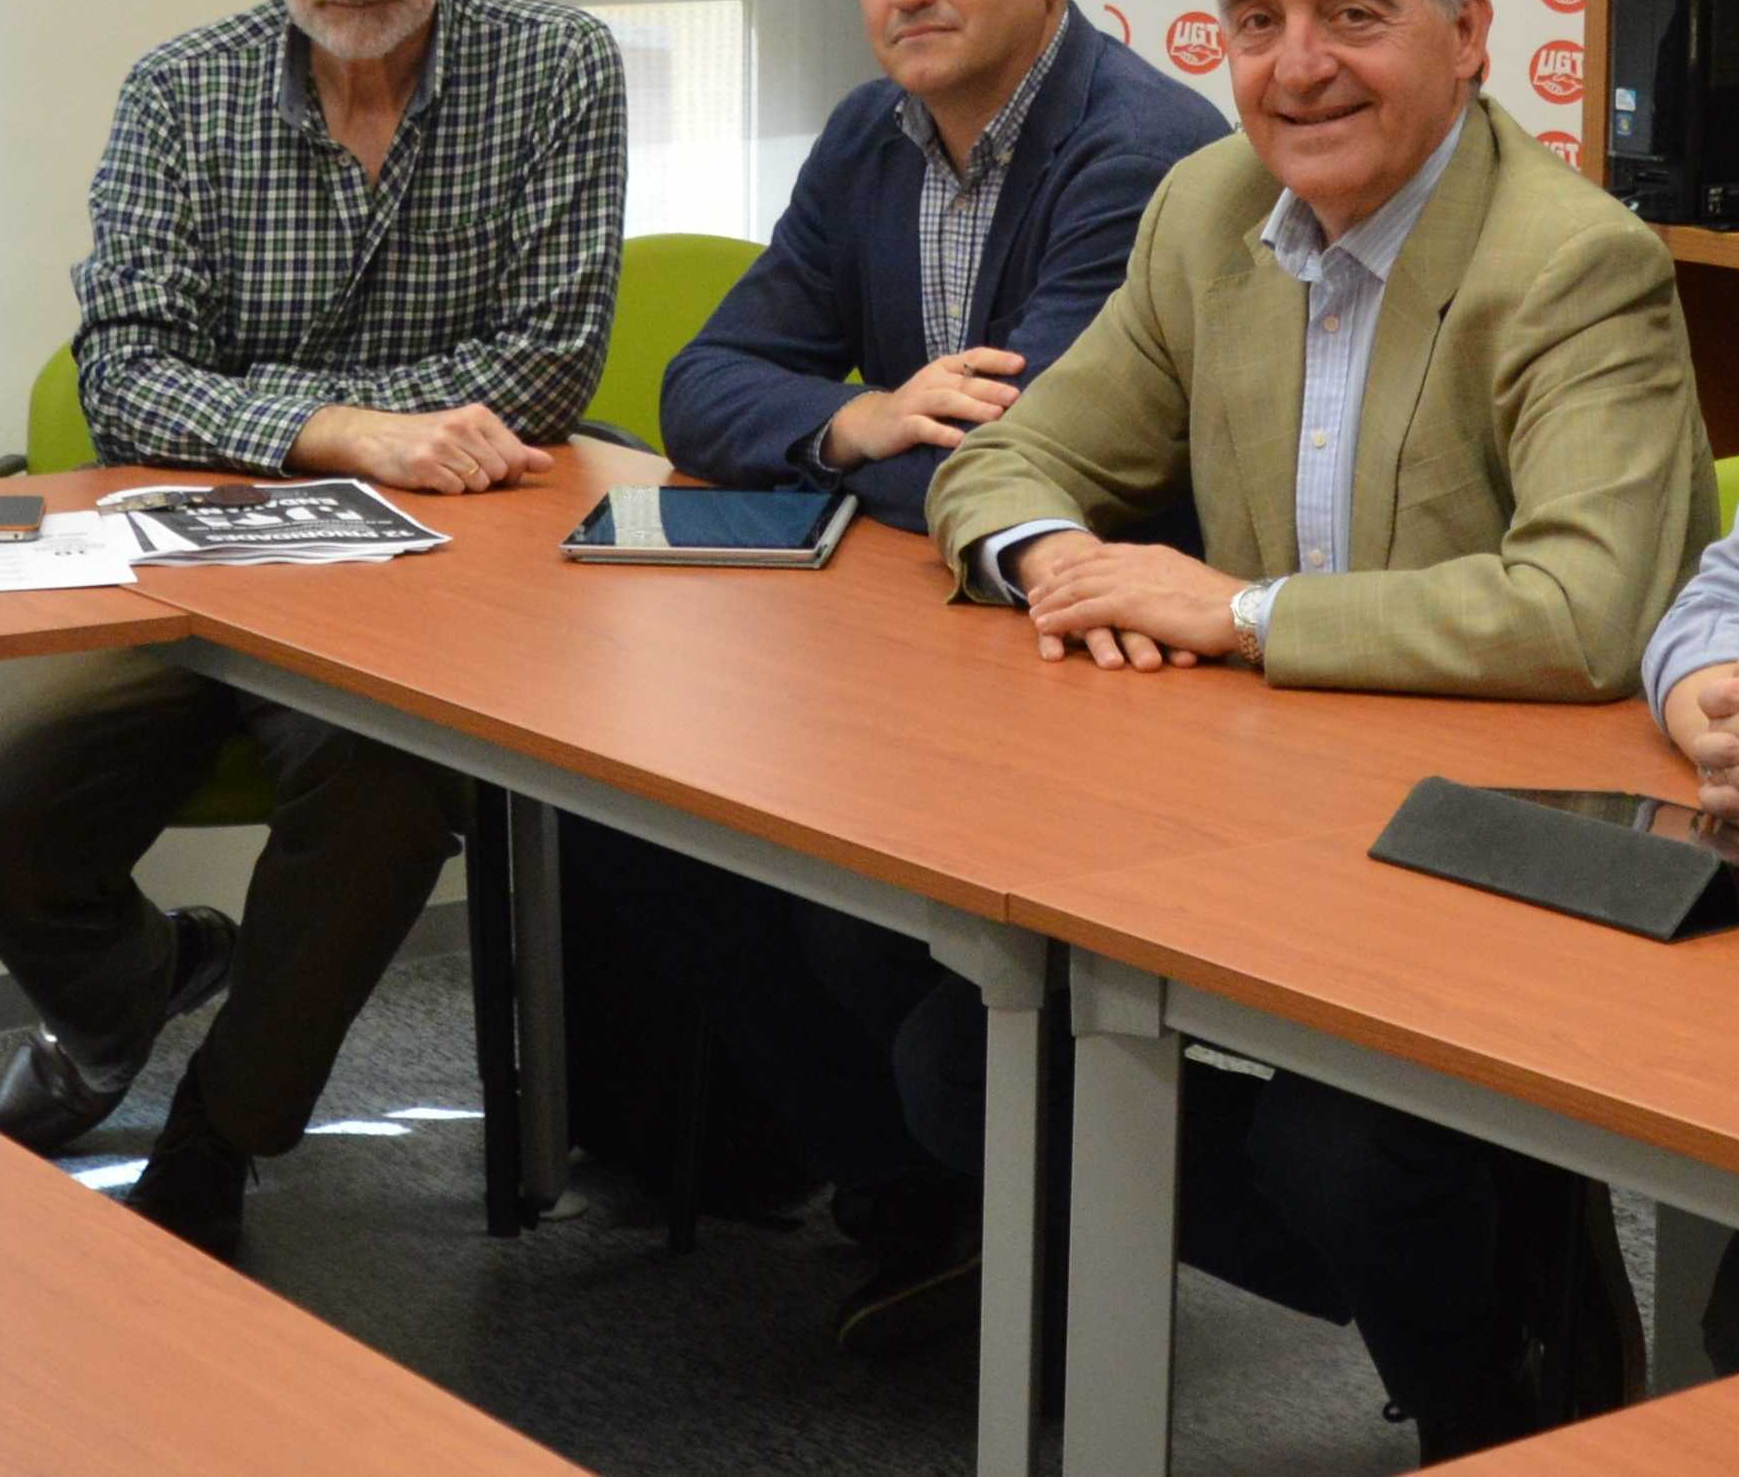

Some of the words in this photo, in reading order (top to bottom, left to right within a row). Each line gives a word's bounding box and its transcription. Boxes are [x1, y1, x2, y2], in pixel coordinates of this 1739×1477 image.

[1175, 22, 1221, 47] UGT
[1538, 50, 1583, 78] UGT
[206, 530, 379, 542] PRIORIDADES
